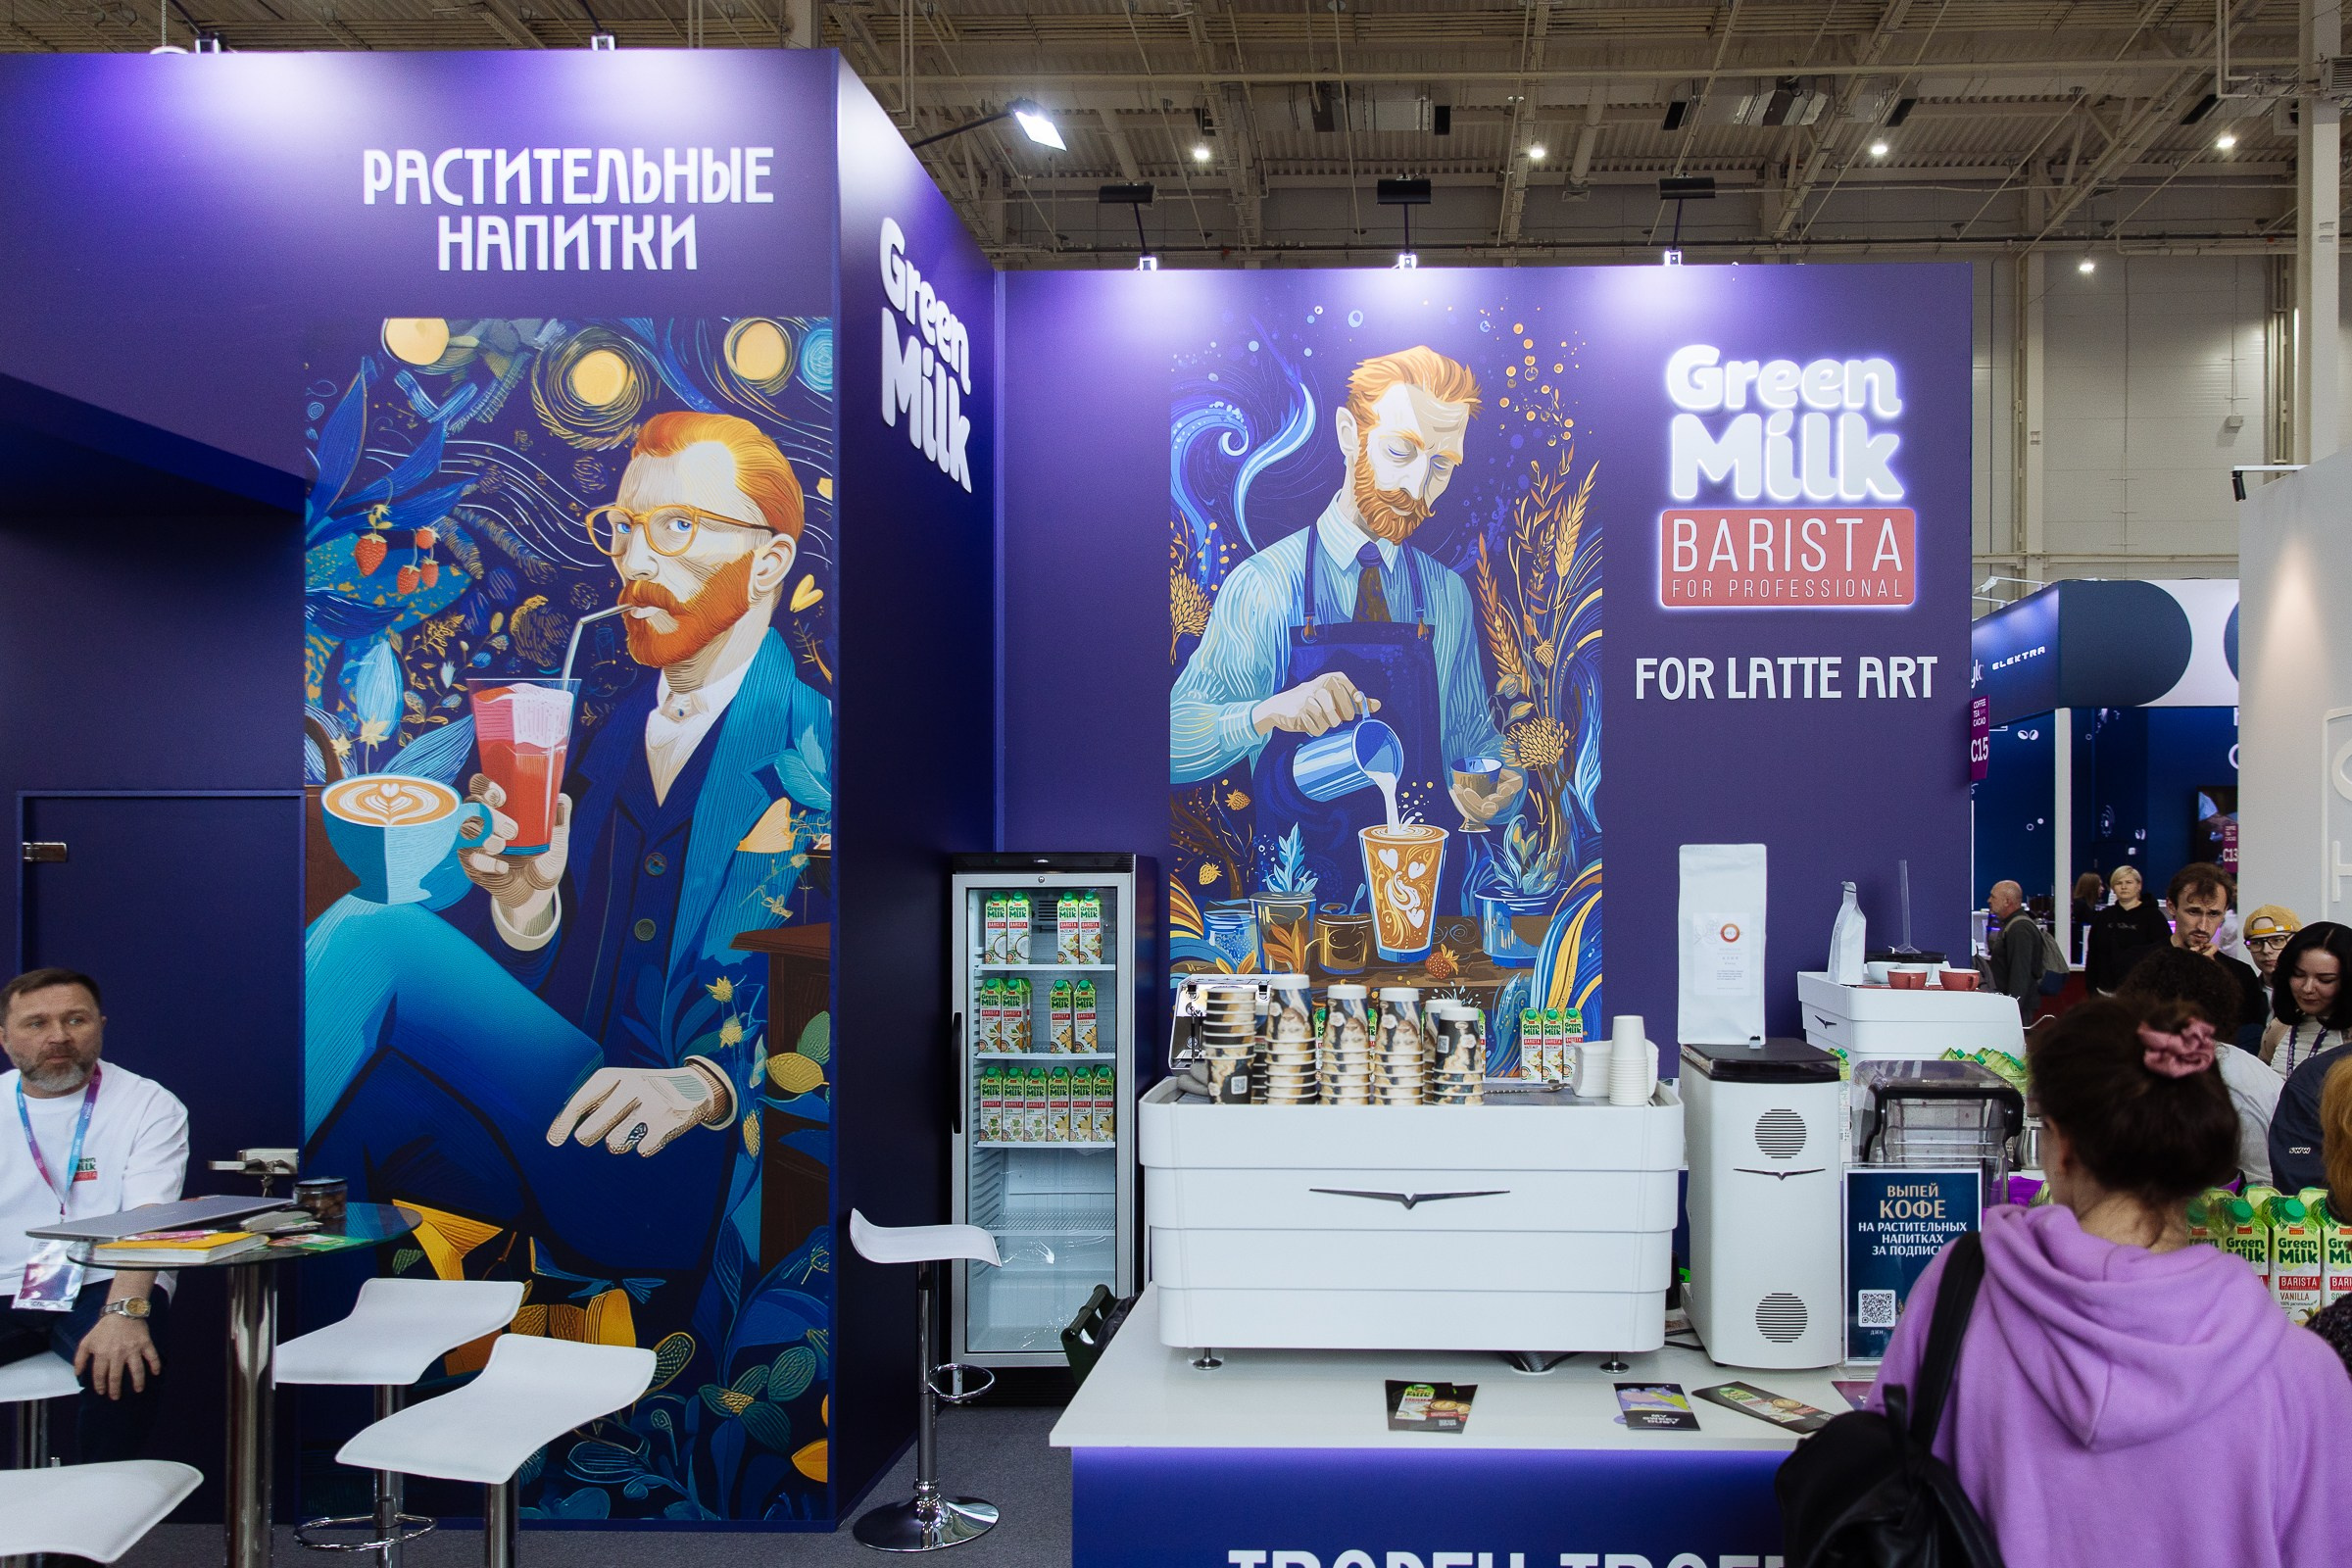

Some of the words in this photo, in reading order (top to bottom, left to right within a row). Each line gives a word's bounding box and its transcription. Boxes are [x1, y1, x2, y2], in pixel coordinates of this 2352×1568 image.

[364, 147, 774, 206] РАСТИТЕЛЬНЫЕ
[438, 214, 697, 270] НАПИТКИ
[880, 217, 971, 395] Green
[1667, 345, 1902, 416] Green
[882, 307, 972, 494] Milk
[1672, 410, 1905, 500] Milk
[1672, 517, 1903, 572] BARISTA
[1672, 579, 1713, 598] FOR
[1728, 579, 1903, 598] PROFESSIONAL
[1991, 646, 2046, 670] ELEKTRA
[1636, 658, 1715, 700] FOR
[1727, 657, 1842, 699] LATTE
[1858, 657, 1938, 699] ART
[1971, 736, 1988, 762] C15
[1887, 1183, 1938, 1198] ВЫПЕЙ
[1880, 1200, 1946, 1219] КОФЕ
[1858, 1222, 1874, 1232] НА
[1878, 1222, 1967, 1232] РАСТИТЕЛЬНЫХ
[1882, 1234, 1944, 1244] НАПИТКАХ
[2226, 1238, 2265, 1250] Green
[2278, 1237, 2318, 1250] Green
[1872, 1245, 1886, 1255] ЗА
[1889, 1245, 1941, 1257] ПОДПИС
[2278, 1250, 2319, 1264] Milk
[2280, 1277, 2318, 1287] BARISTA
[2279, 1292, 2310, 1301] VANILLA
